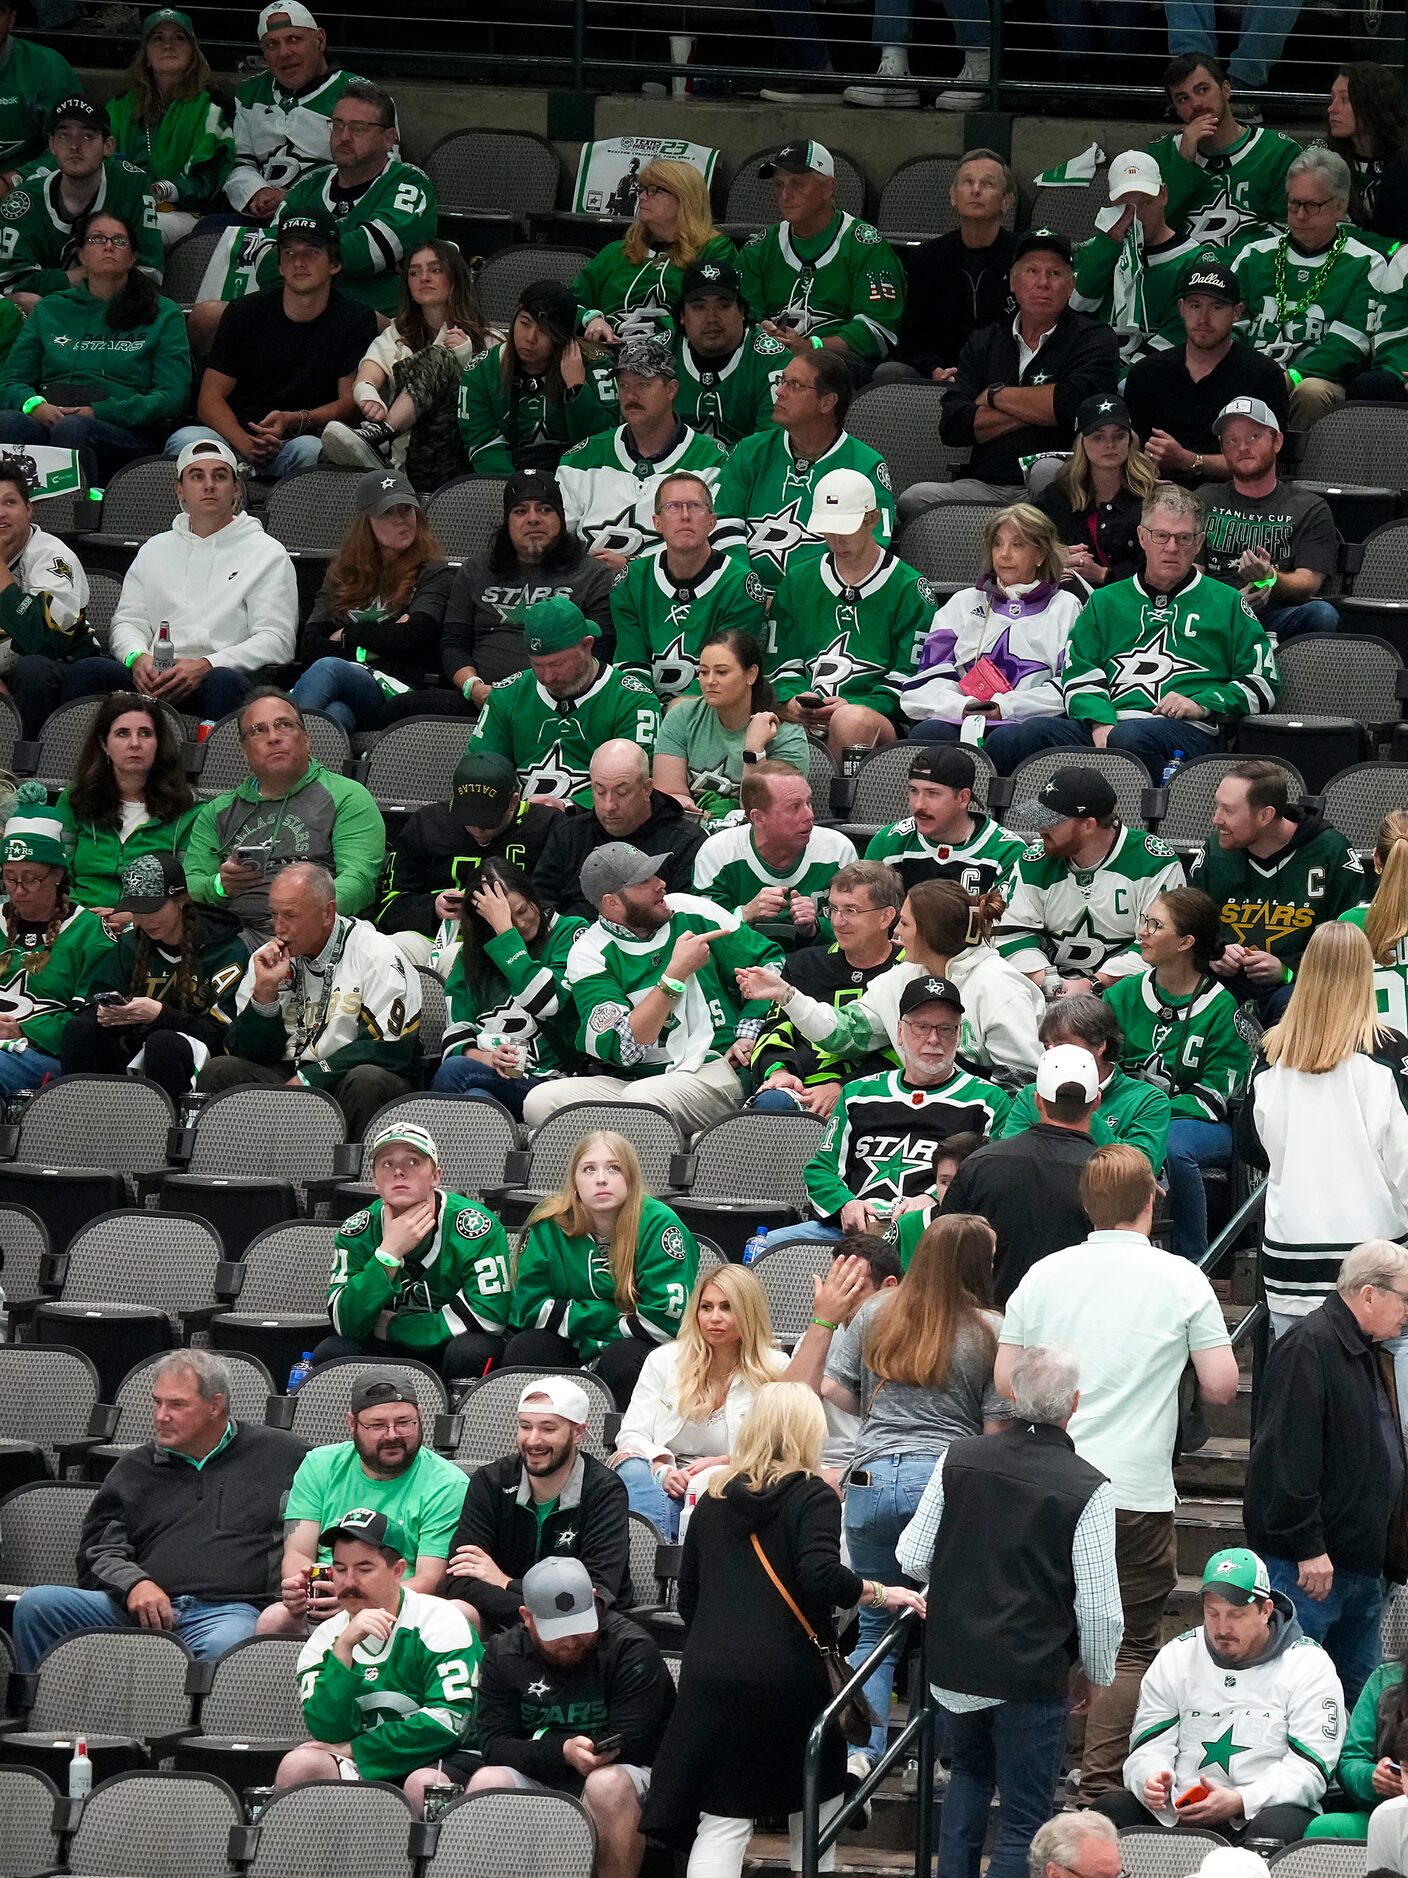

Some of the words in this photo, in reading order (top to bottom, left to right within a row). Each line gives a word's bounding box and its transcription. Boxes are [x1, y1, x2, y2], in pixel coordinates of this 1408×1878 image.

[56, 98, 95, 114] DALLAS
[631, 144, 661, 152] HOCKEY
[660, 141, 689, 155] 23
[633, 138, 662, 146] TEXAS
[393, 182, 428, 216] 21
[1235, 181, 1249, 209] C
[282, 219, 316, 230] STARS
[866, 270, 897, 301] 16
[1188, 272, 1226, 288] Dallas
[72, 340, 146, 352] STARS
[1211, 506, 1264, 523] STANLEY
[1268, 513, 1293, 523] CUP
[1206, 514, 1294, 559] PLAYOFFS
[481, 583, 574, 604] STARS
[1184, 612, 1200, 638] C
[1252, 643, 1278, 680] 14
[457, 783, 497, 799] DALLAS
[233, 812, 276, 848] LLAS
[281, 813, 310, 852] STARS
[960, 868, 981, 897] C
[1308, 866, 1325, 898] C
[1115, 888, 1129, 914] C
[1220, 900, 1317, 929] STARS
[1227, 897, 1311, 908] DALLAS
[211, 961, 243, 997] A
[387, 997, 406, 1037] 9
[1182, 1034, 1205, 1068] C
[854, 1132, 940, 1160] STAR
[474, 1255, 511, 1296] 21
[664, 1282, 690, 1319] 2
[519, 1702, 609, 1725] STARS
[1321, 1697, 1338, 1741] 3
